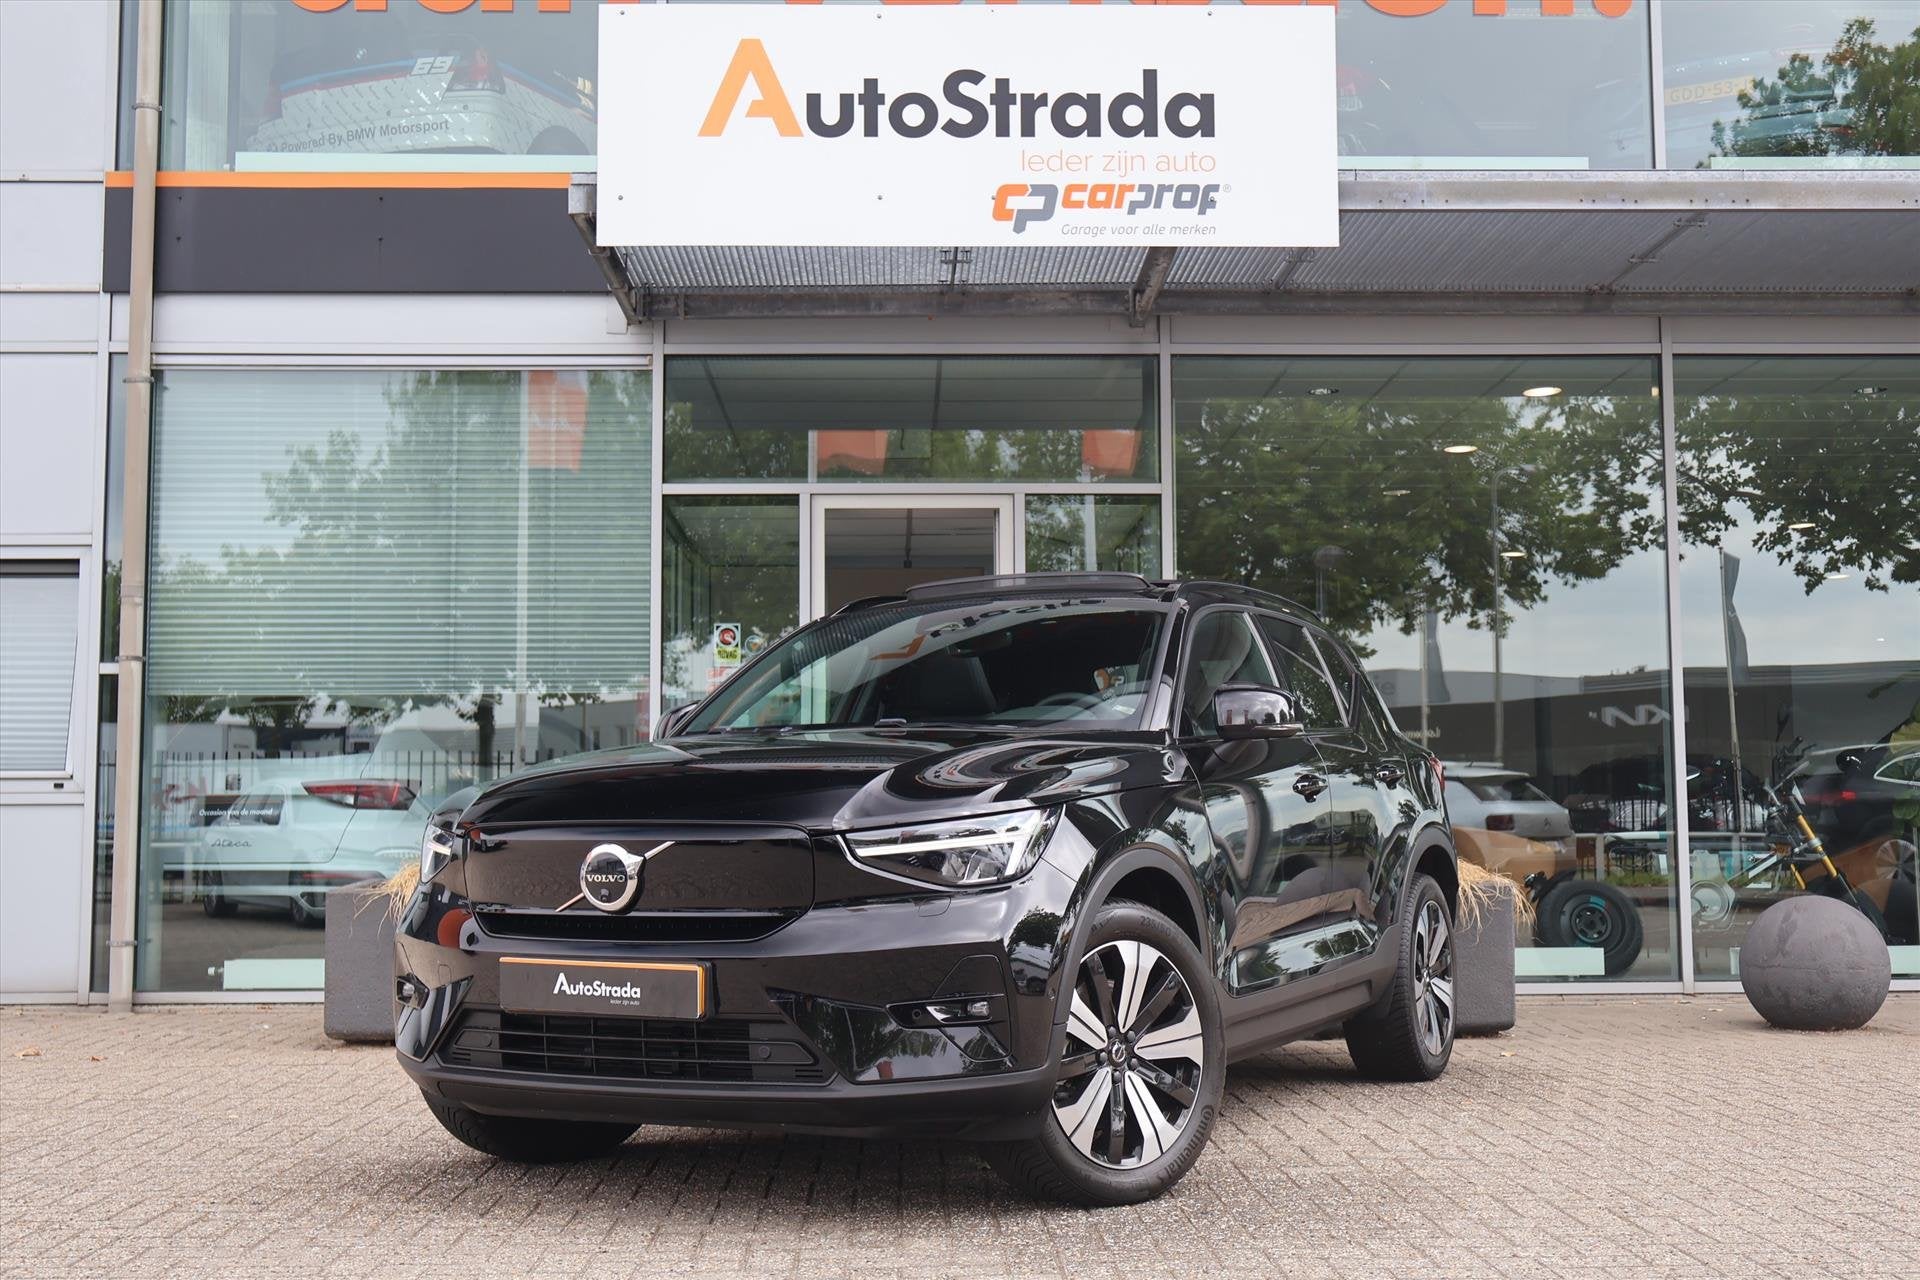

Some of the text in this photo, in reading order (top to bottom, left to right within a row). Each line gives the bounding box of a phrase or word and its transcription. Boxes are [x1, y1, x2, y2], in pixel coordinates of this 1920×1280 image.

[411, 56, 455, 76] 69
[696, 38, 1215, 138] AutoStrada
[281, 119, 450, 151] Powered By BMW Motorsport
[1021, 150, 1217, 178] Ieder zijn auto
[1061, 223, 1217, 238] Garage voor alle merken
[586, 874, 626, 883] VOLVO
[553, 972, 641, 999] AutoStrada
[1163, 1104, 1216, 1180] Continental
